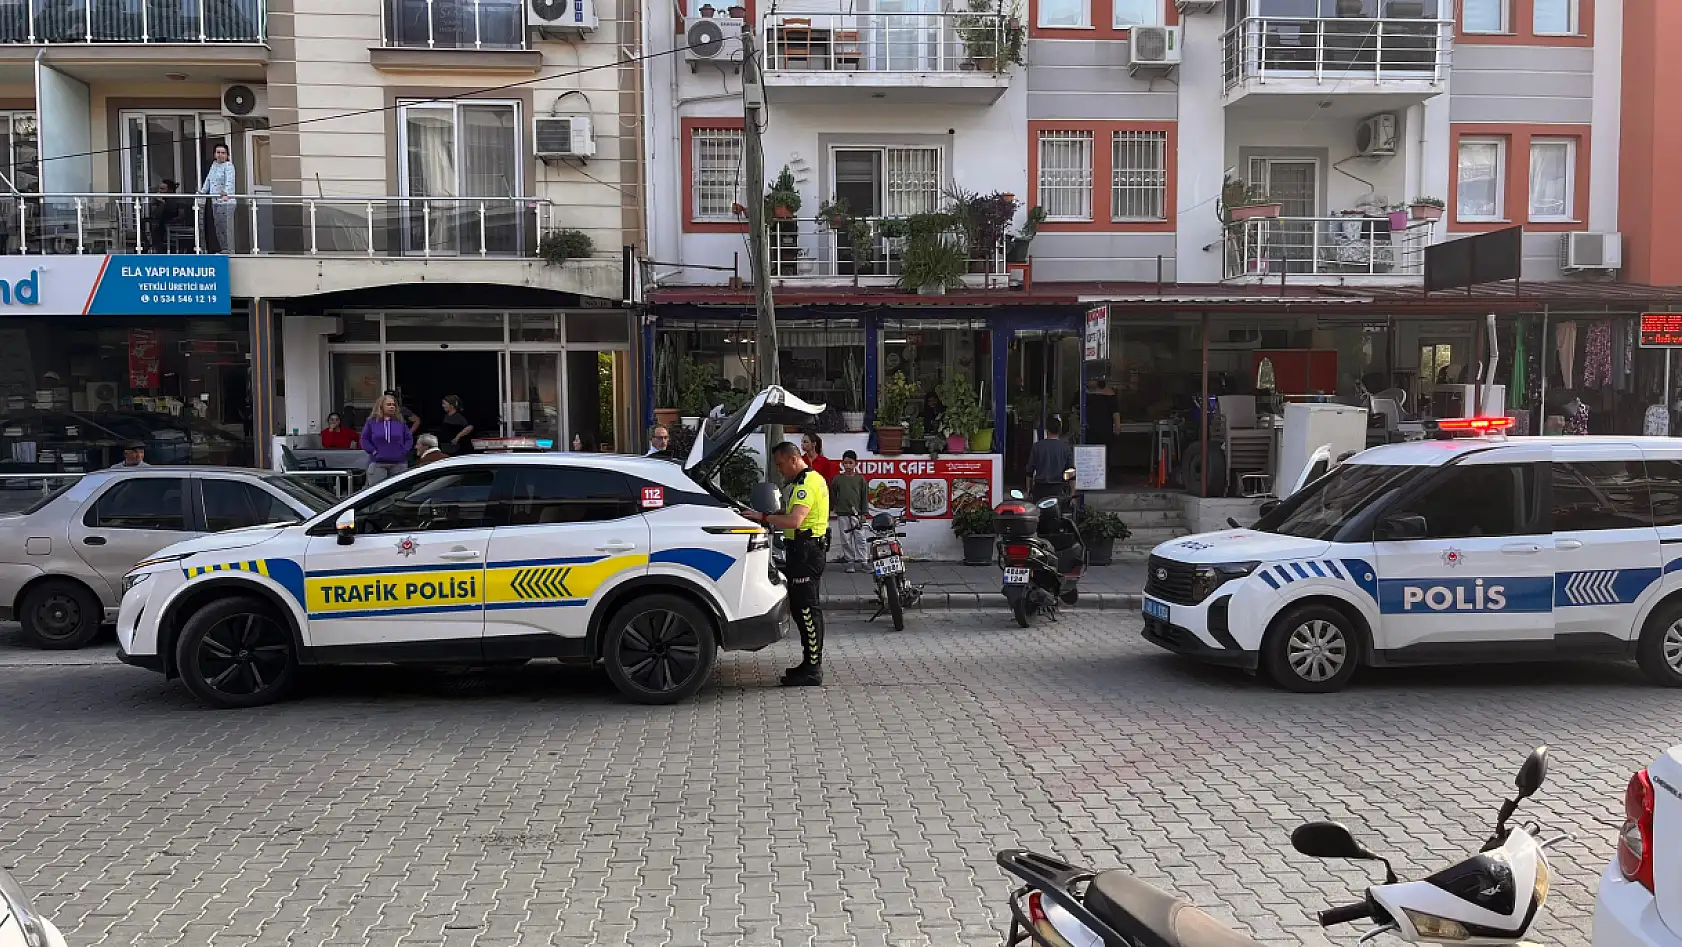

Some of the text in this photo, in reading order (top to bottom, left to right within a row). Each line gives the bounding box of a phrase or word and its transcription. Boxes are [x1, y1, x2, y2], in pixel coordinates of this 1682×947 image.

[121, 266, 216, 277] ELA YAPI PANJUR
[138, 281, 167, 291] YETKİLİ
[153, 294, 217, 303] 0 534 546 12 19
[898, 461, 936, 475] CAFE
[644, 489, 661, 499] 112
[320, 576, 476, 603] TRAFİK POLİSİ
[1403, 578, 1506, 610] POLİS
